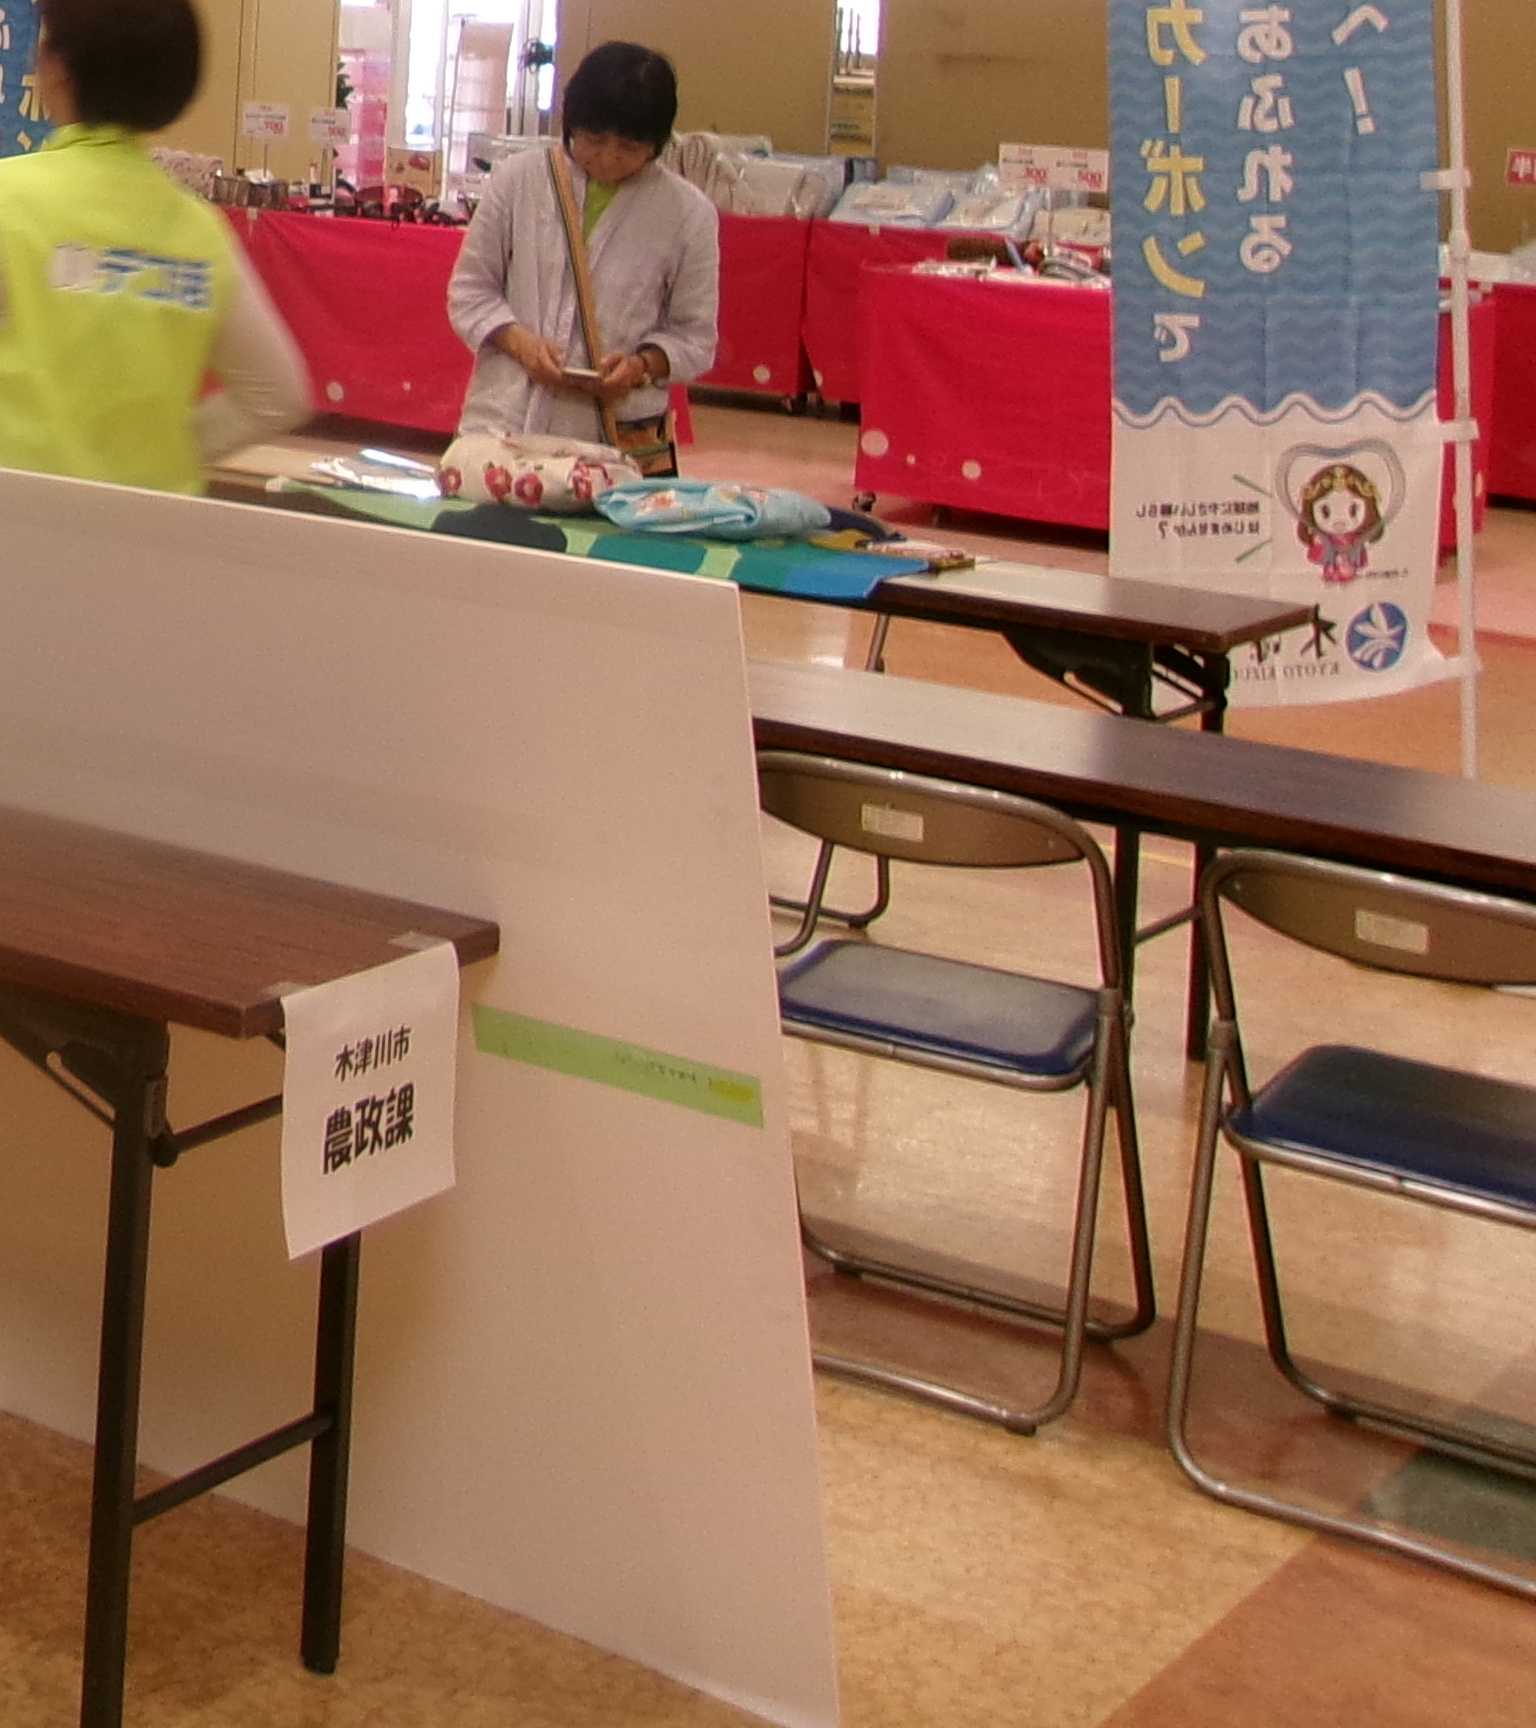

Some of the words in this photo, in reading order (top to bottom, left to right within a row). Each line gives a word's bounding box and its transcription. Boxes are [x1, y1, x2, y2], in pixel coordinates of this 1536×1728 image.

[333, 1023, 413, 1083] 木津川市
[322, 1082, 416, 1176] 農政課
